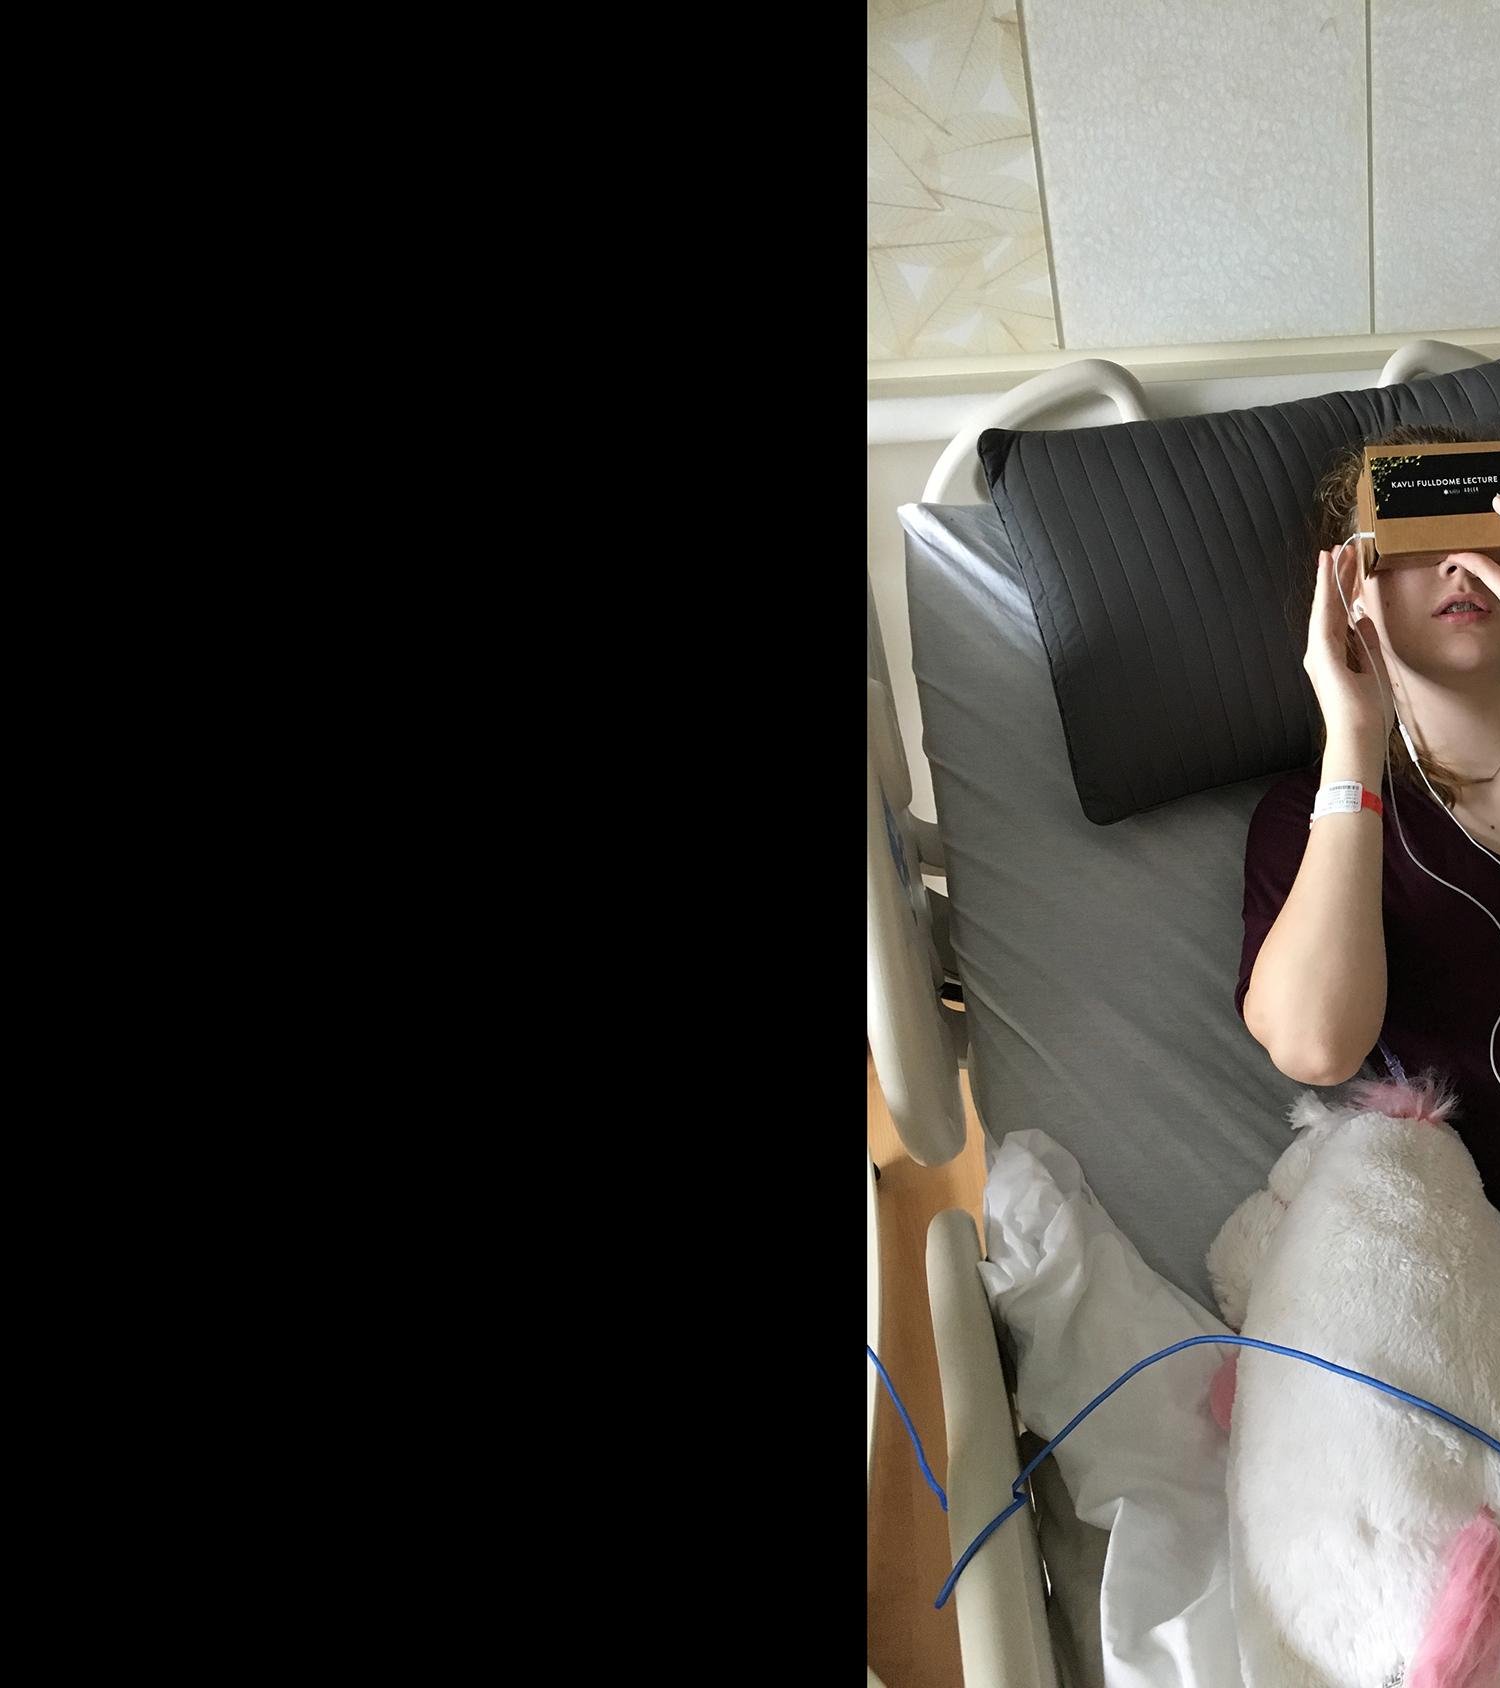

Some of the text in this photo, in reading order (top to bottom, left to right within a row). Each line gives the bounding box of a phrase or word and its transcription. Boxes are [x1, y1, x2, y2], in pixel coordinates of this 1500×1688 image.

[1391, 480, 1415, 489] KAVLI
[1416, 477, 1461, 488] FULLDOME
[1462, 475, 1498, 485] LECTURE
